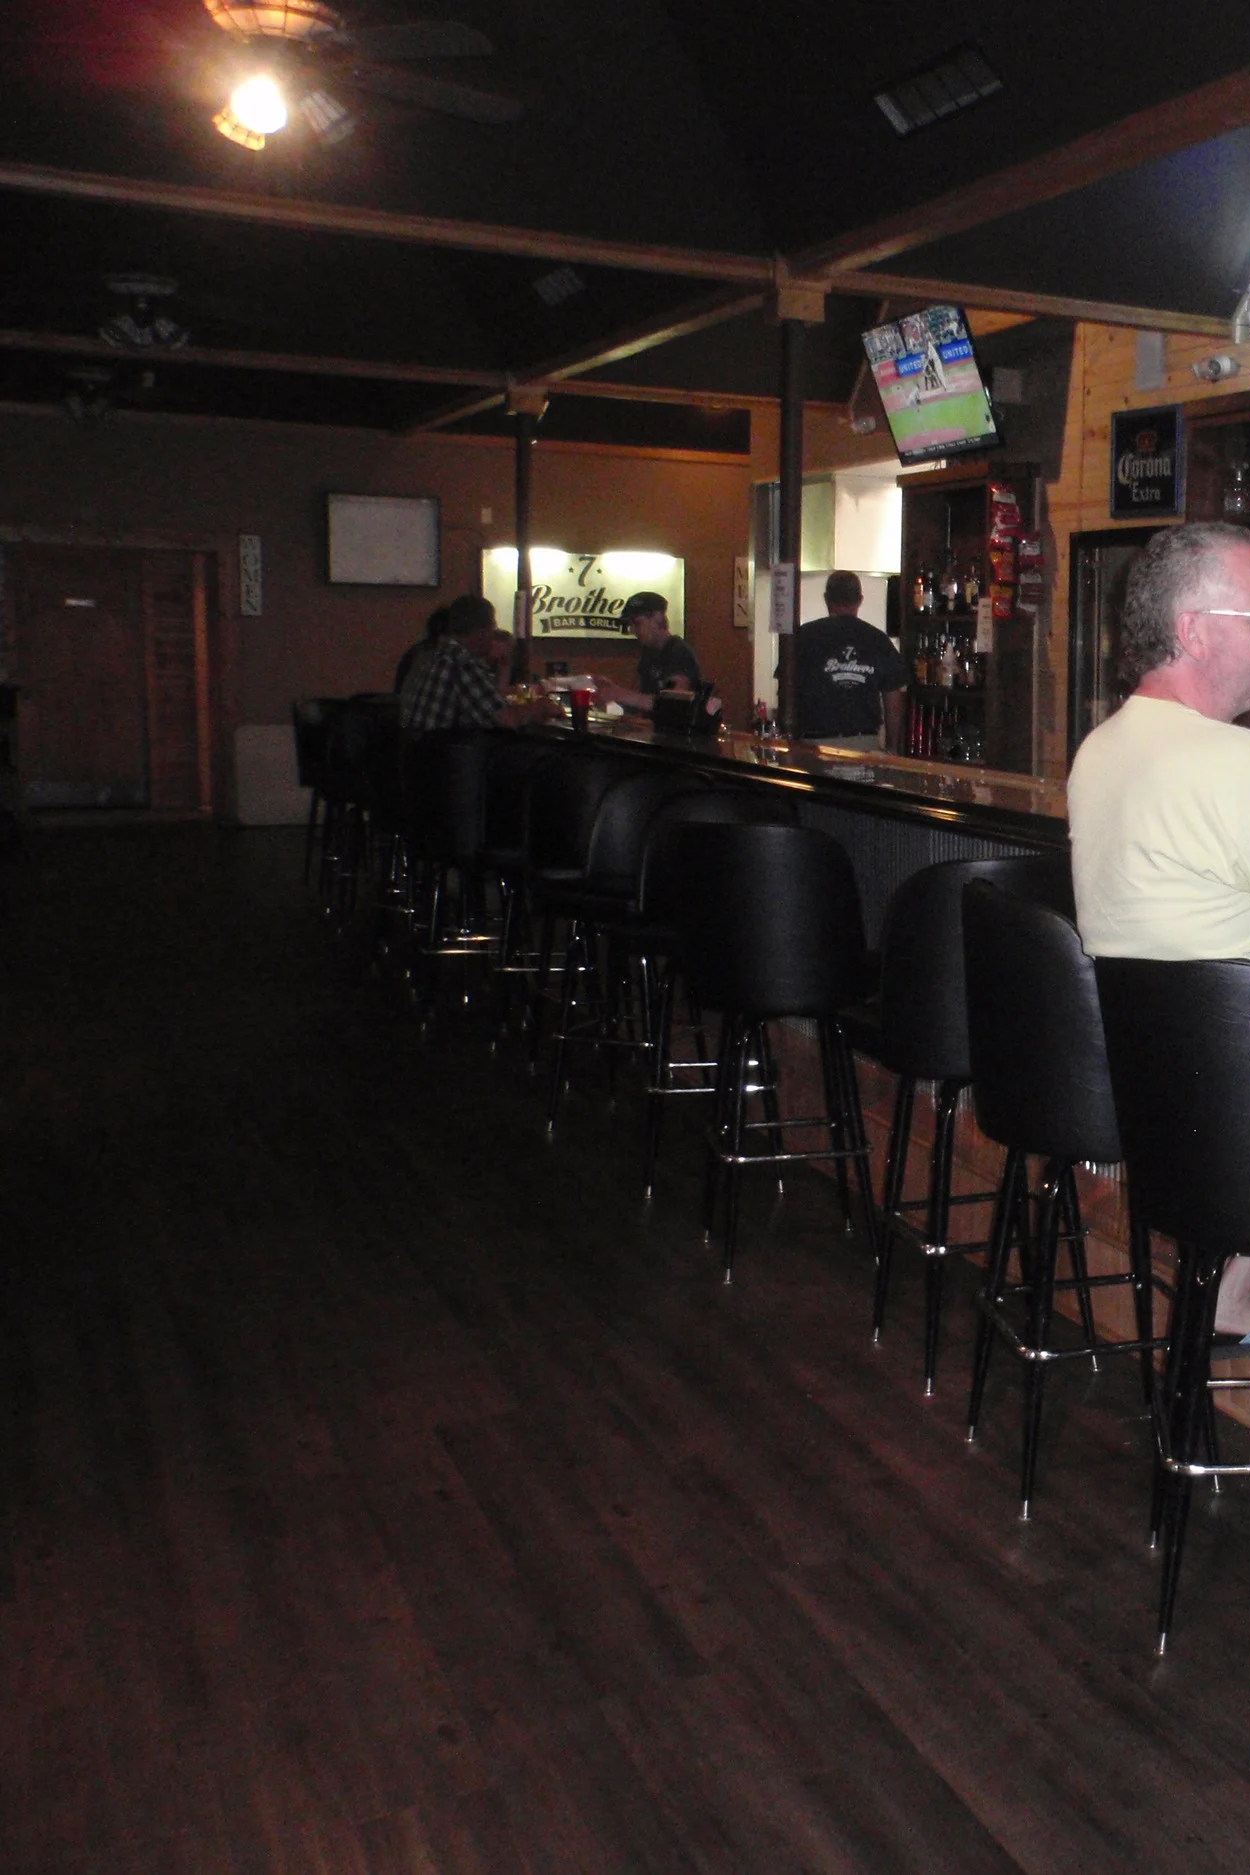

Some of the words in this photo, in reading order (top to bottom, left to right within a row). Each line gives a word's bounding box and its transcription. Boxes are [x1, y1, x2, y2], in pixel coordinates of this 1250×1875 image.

[943, 345, 968, 359] UNITED
[1117, 451, 1172, 485] Corona
[1131, 482, 1161, 501] Extra
[578, 556, 597, 587] 7
[532, 584, 625, 615] Brothe
[553, 617, 576, 628] BAR
[578, 618, 585, 627] &
[589, 618, 618, 629] GRILL
[824, 658, 875, 674] Brothers
